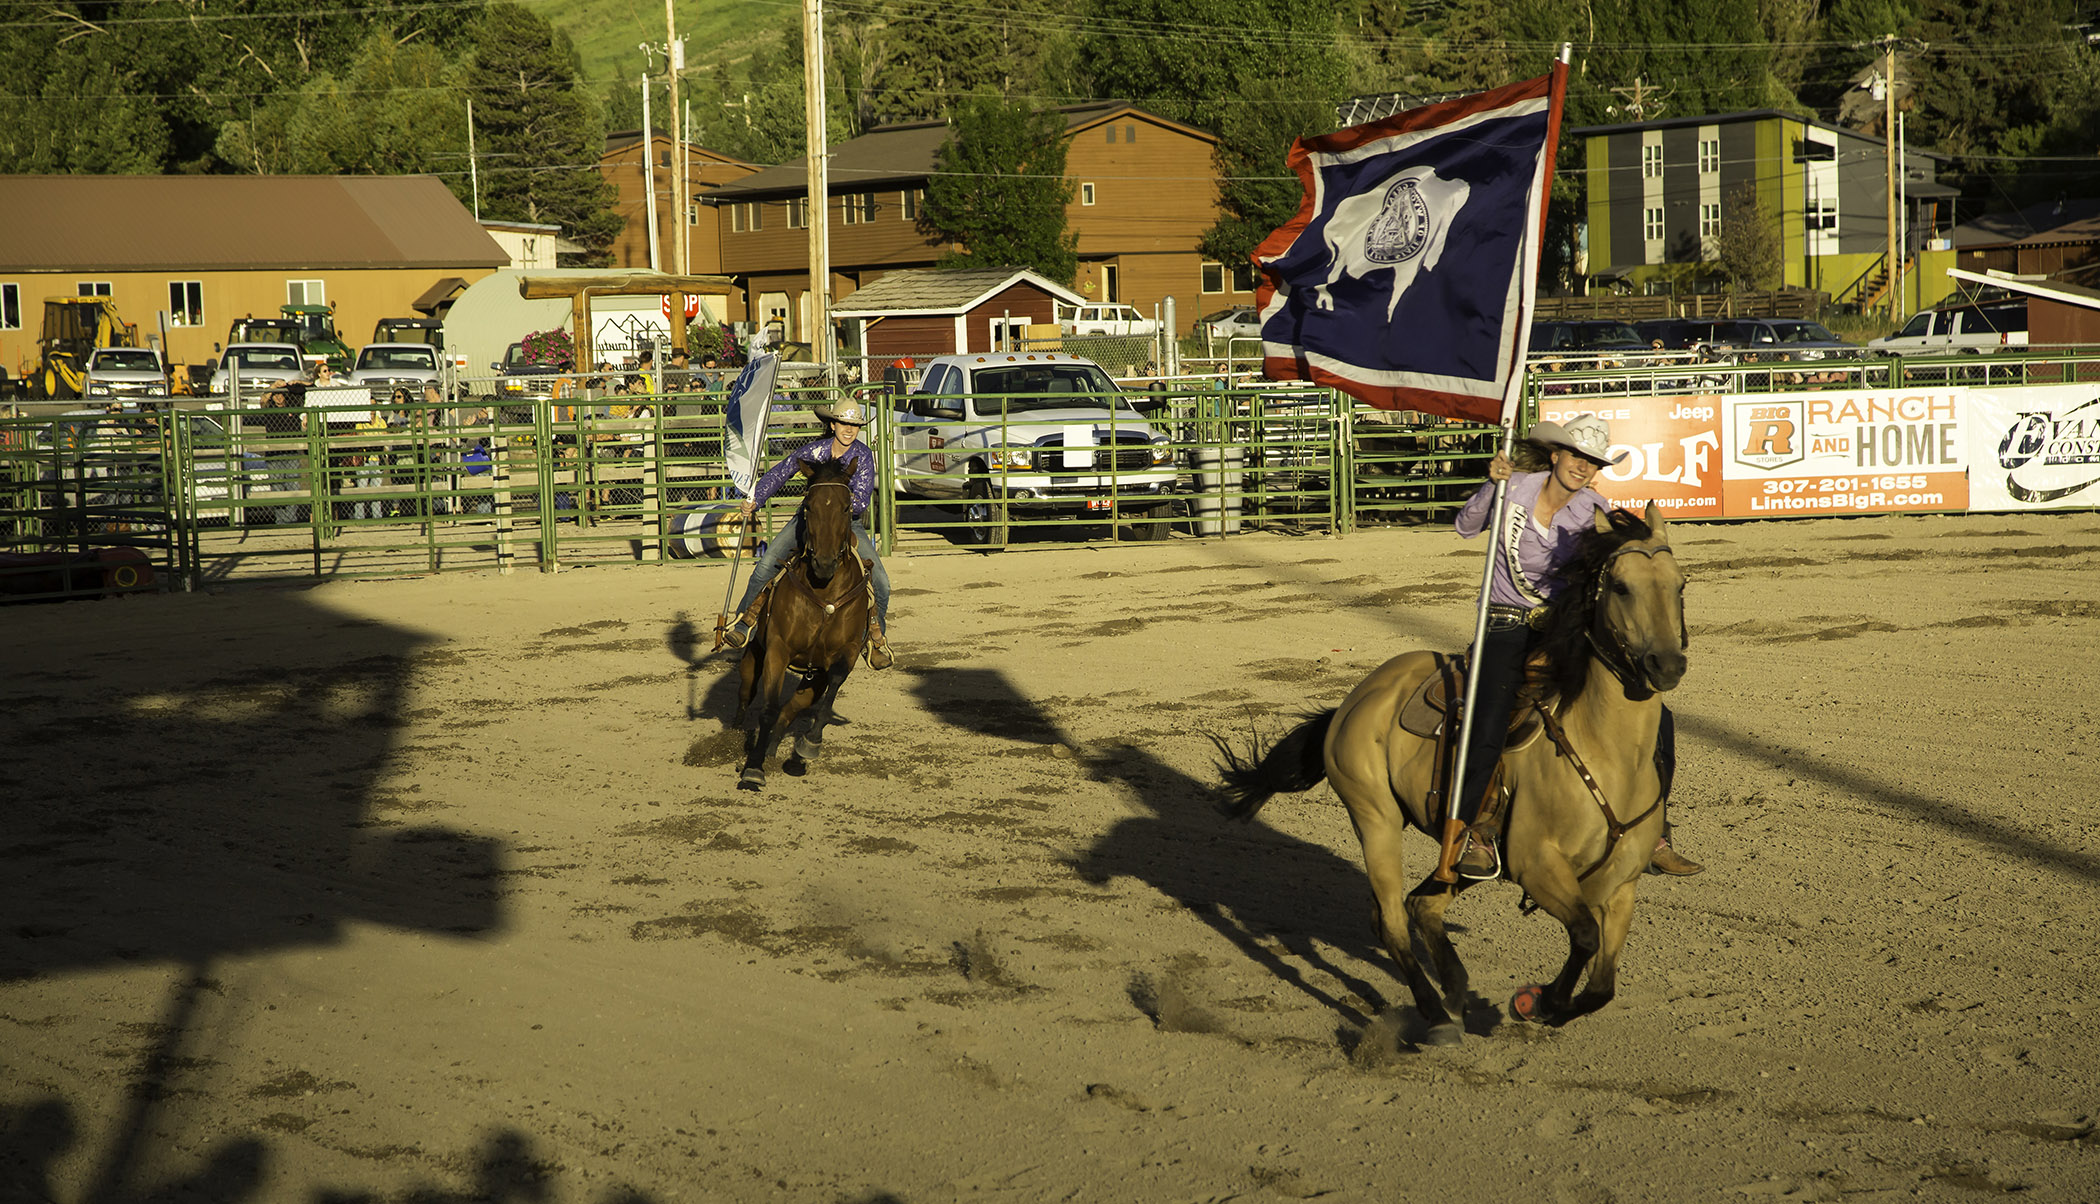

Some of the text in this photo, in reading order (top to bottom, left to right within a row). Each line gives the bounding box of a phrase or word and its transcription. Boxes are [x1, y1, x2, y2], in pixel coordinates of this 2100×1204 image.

[663, 295, 698, 312] SP
[1669, 403, 1714, 422] Jeep
[1750, 406, 1791, 420] BIG
[1807, 395, 1956, 424] RANCH
[1742, 420, 1795, 456] R
[1811, 437, 1850, 453] AND
[1856, 422, 1958, 467] HOME
[1600, 430, 1720, 488] OLF
[1763, 476, 1928, 494] 307-201-1655
[1751, 491, 1944, 511] LintonsBigR.com
